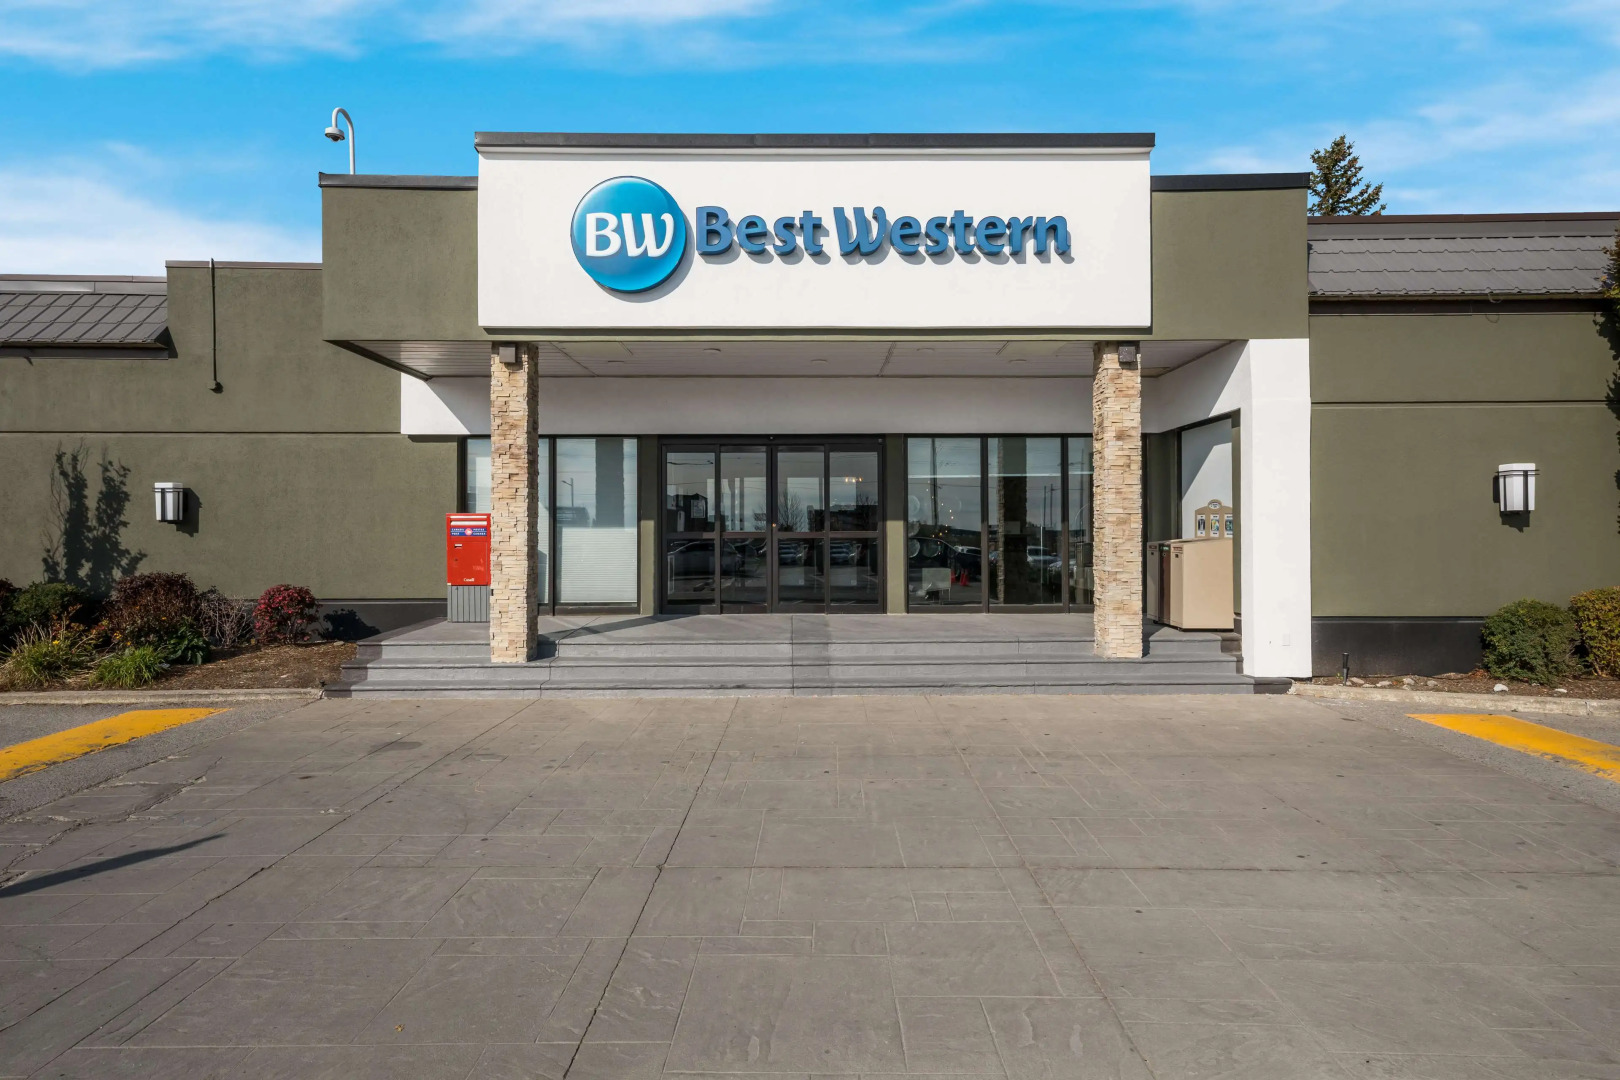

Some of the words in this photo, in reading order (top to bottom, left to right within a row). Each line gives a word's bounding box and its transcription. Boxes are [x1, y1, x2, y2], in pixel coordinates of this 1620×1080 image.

[586, 212, 674, 257] BW
[695, 206, 823, 256] Best
[833, 206, 1071, 256] Western
